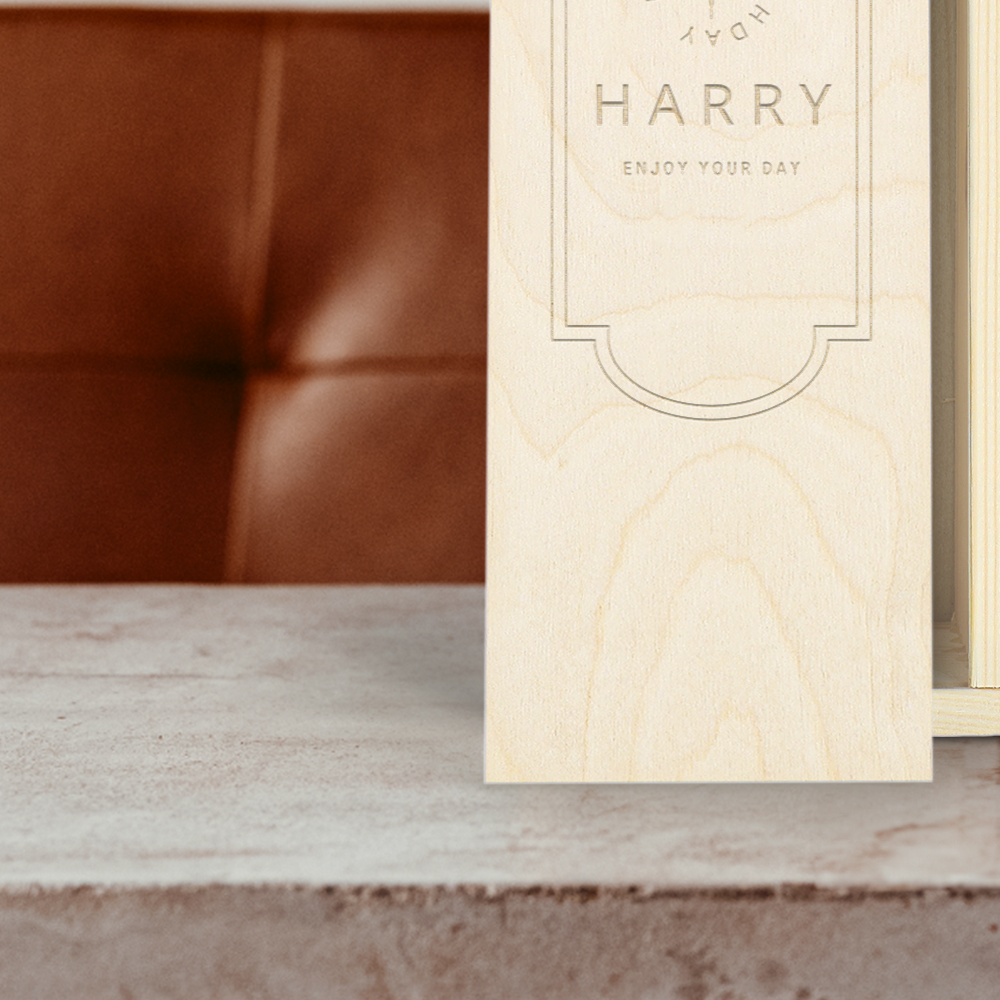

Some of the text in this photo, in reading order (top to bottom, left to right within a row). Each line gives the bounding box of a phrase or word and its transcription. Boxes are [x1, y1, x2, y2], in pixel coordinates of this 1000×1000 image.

[596, 83, 832, 126] HARRY
[623, 161, 801, 176] ENJOY YOUR DAY
